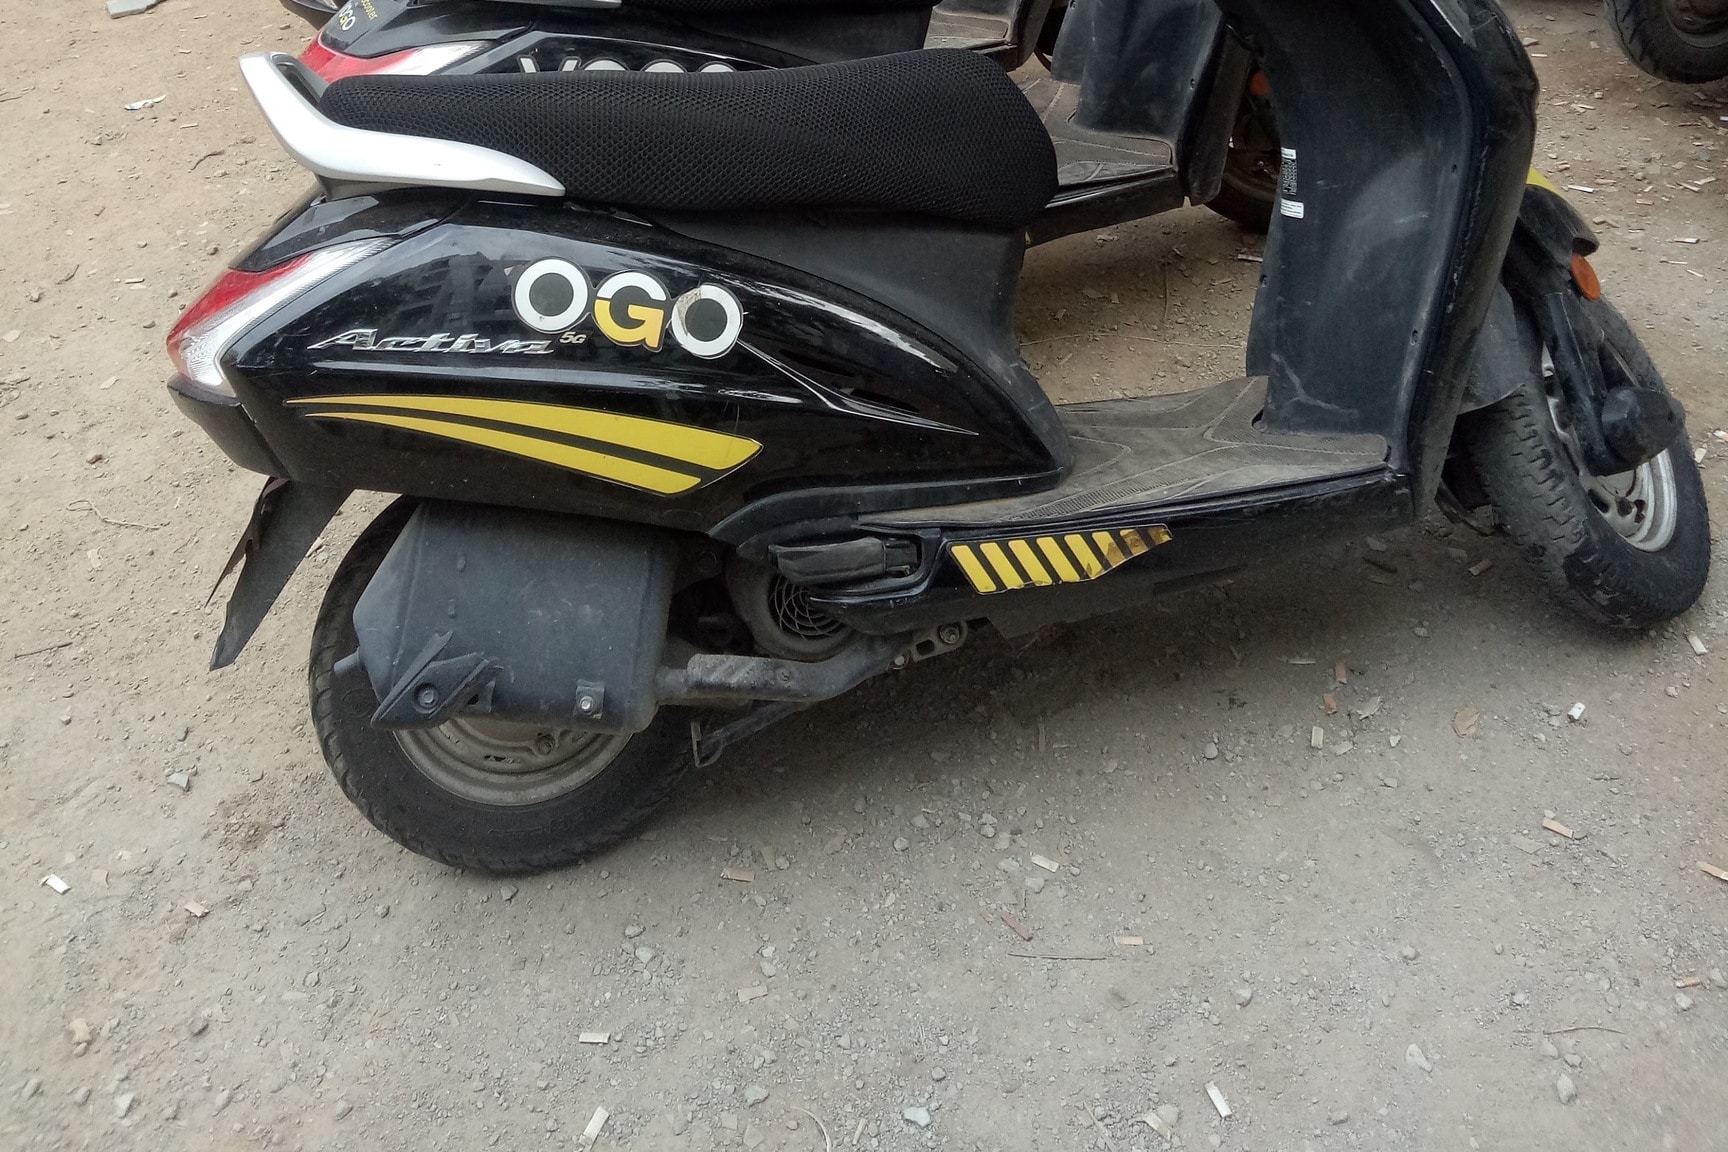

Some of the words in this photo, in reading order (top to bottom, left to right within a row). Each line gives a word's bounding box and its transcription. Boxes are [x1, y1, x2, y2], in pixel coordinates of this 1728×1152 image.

[514, 258, 744, 357] OGO
[307, 328, 555, 355] Activa
[559, 330, 588, 345] 5G
